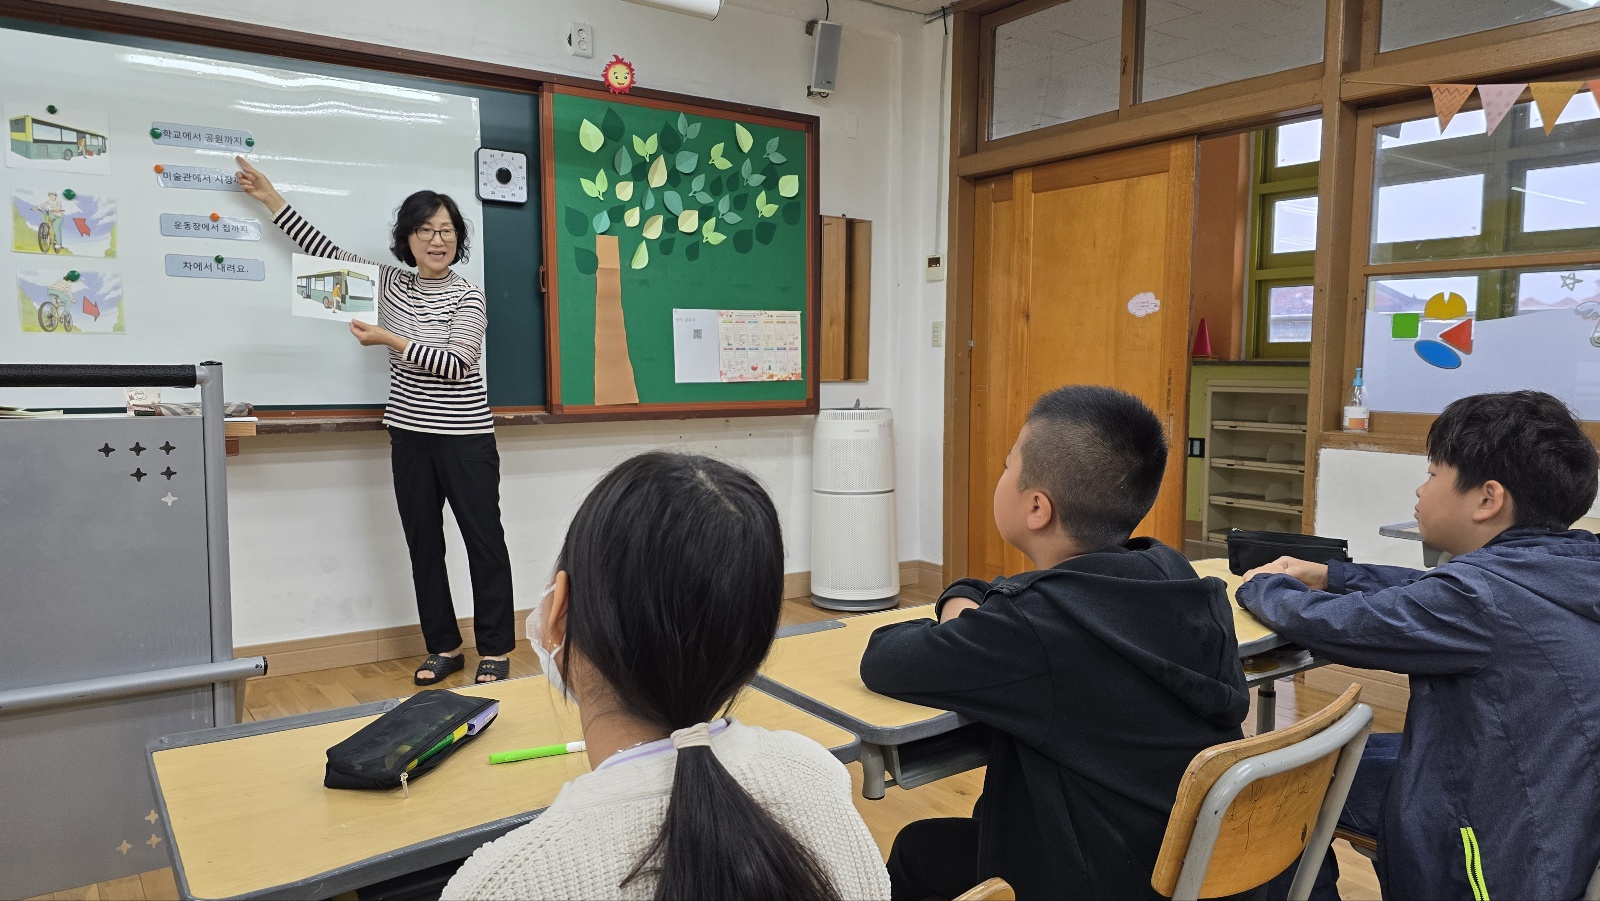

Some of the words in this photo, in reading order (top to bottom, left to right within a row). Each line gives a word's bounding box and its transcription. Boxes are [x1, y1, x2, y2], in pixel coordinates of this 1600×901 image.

[162, 129, 202, 141] 학교에서
[204, 133, 242, 145] 공원까지
[162, 171, 211, 183] 미술관에서
[173, 221, 219, 232] 운동장에서
[222, 222, 249, 233] 집까지
[182, 261, 213, 272] 차에서
[216, 263, 249, 273] 내려요.
